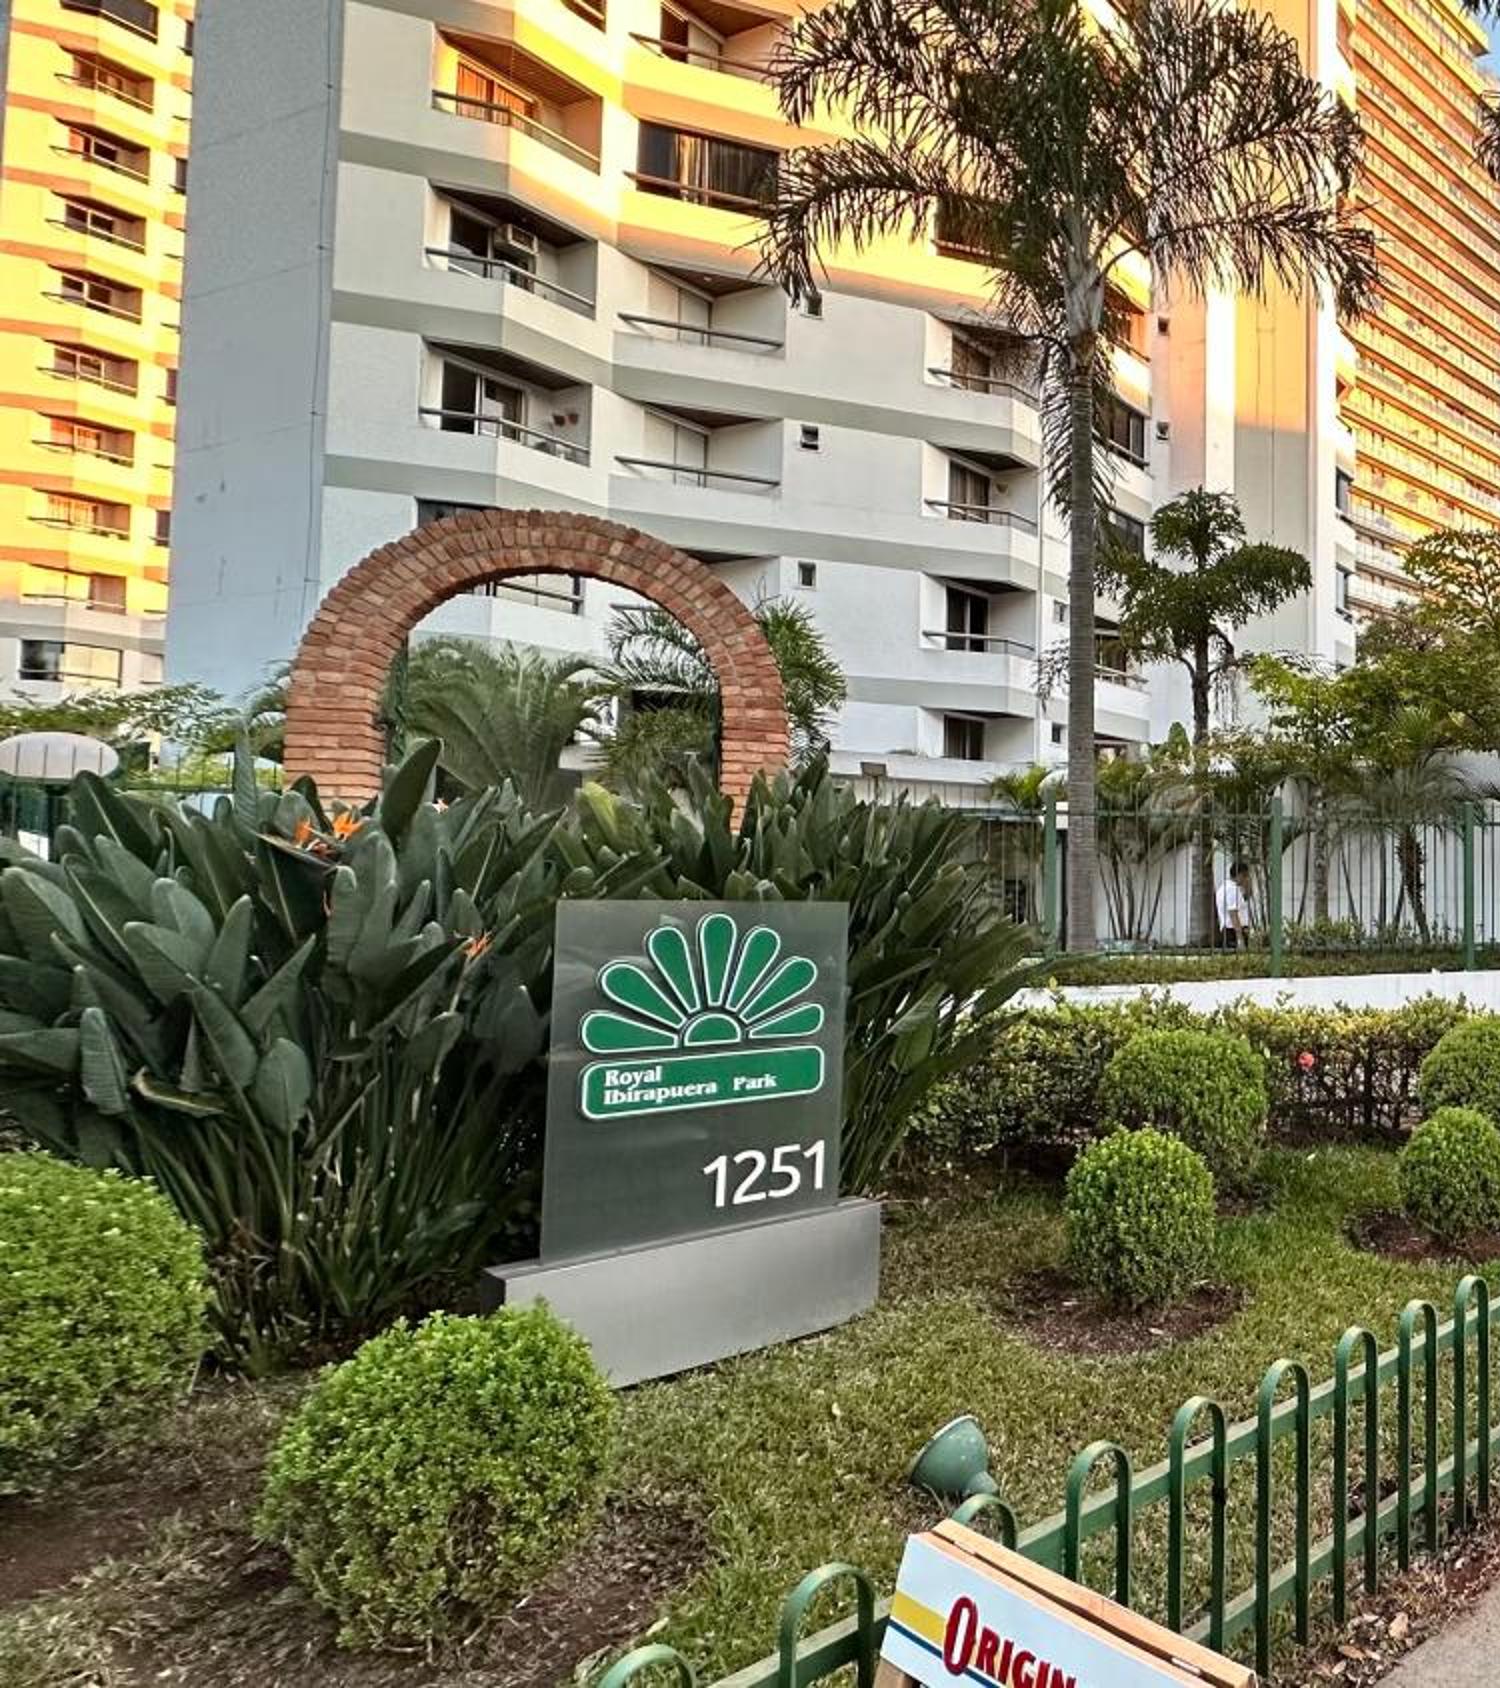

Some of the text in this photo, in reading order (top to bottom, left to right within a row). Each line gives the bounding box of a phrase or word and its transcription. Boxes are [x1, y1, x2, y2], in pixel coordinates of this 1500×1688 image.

[603, 1073, 777, 1104] Ibirapuera Park
[604, 1065, 663, 1090] Royal
[703, 1139, 825, 1208] 1251
